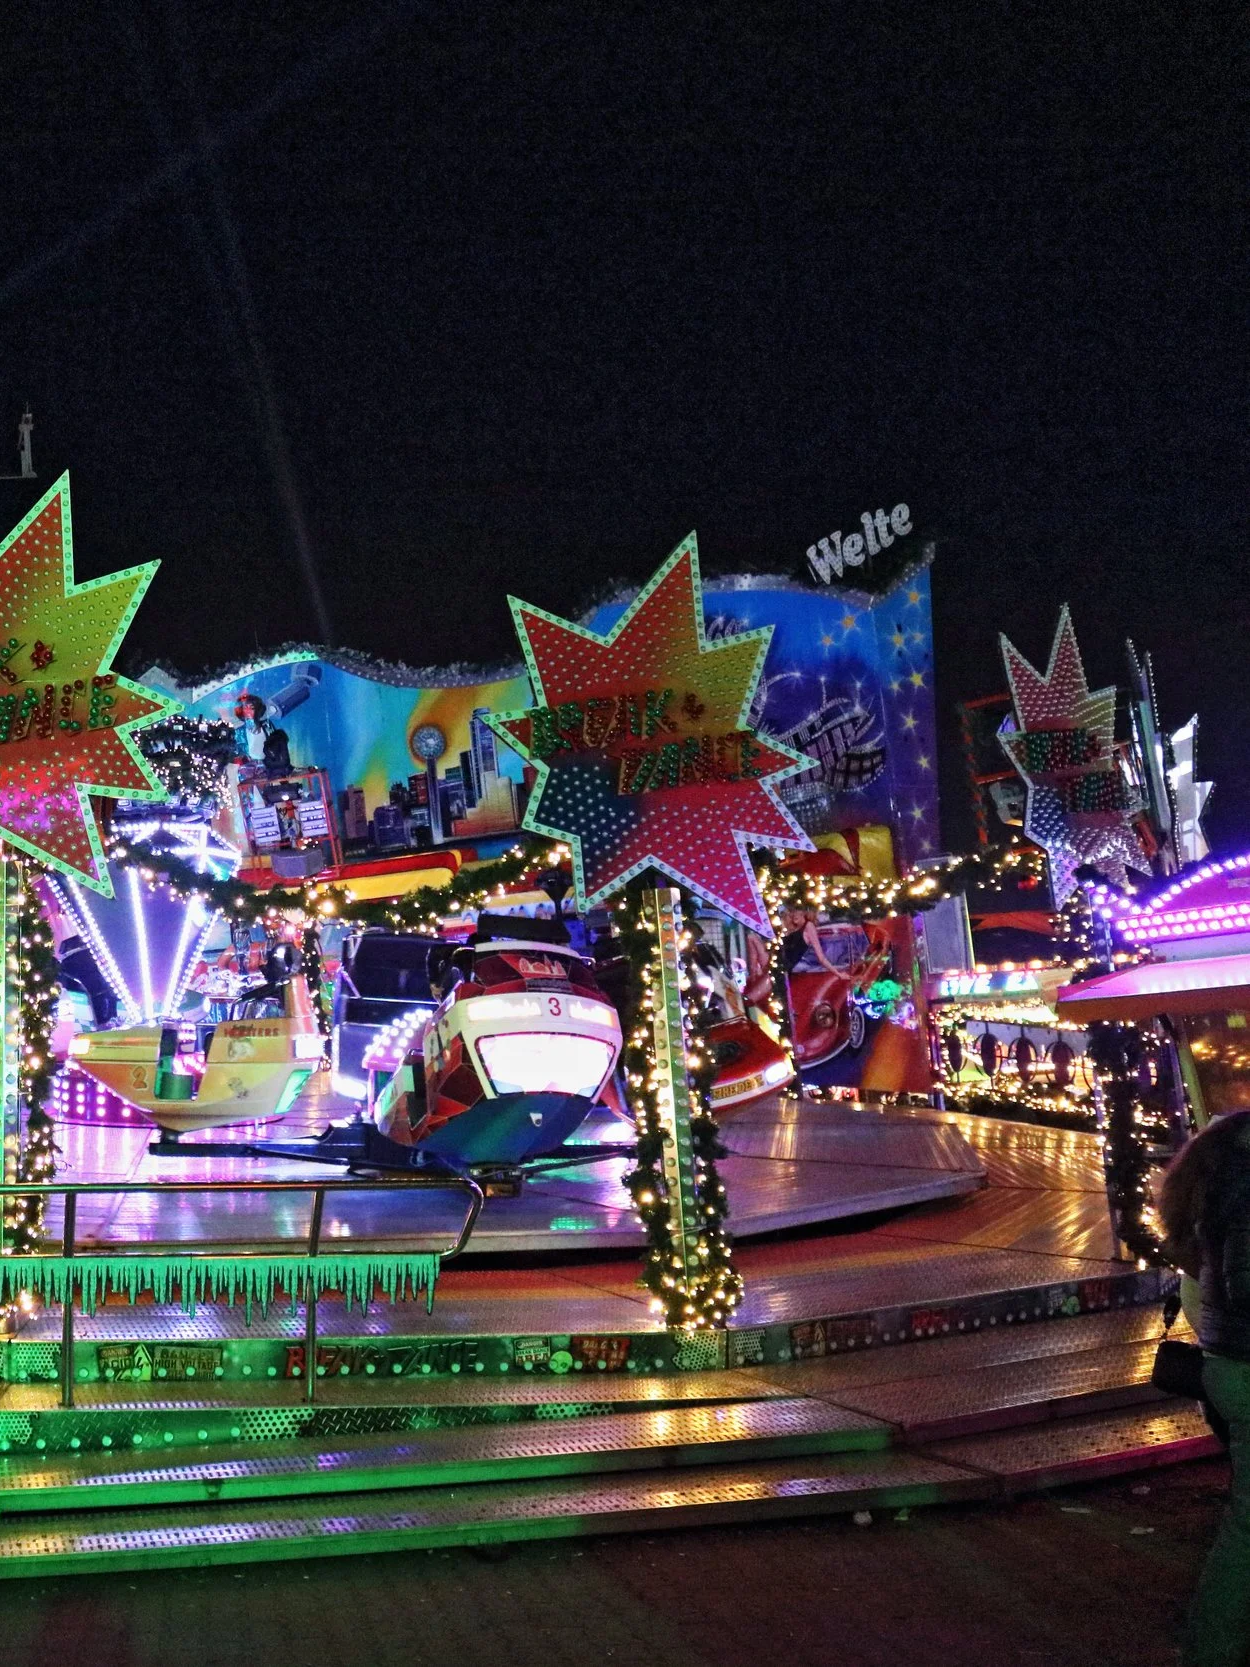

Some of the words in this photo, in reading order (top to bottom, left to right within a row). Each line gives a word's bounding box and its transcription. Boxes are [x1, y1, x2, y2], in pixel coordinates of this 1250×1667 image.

[806, 503, 912, 584] Welte
[549, 997, 561, 1016] 3
[132, 1065, 147, 1089] 2
